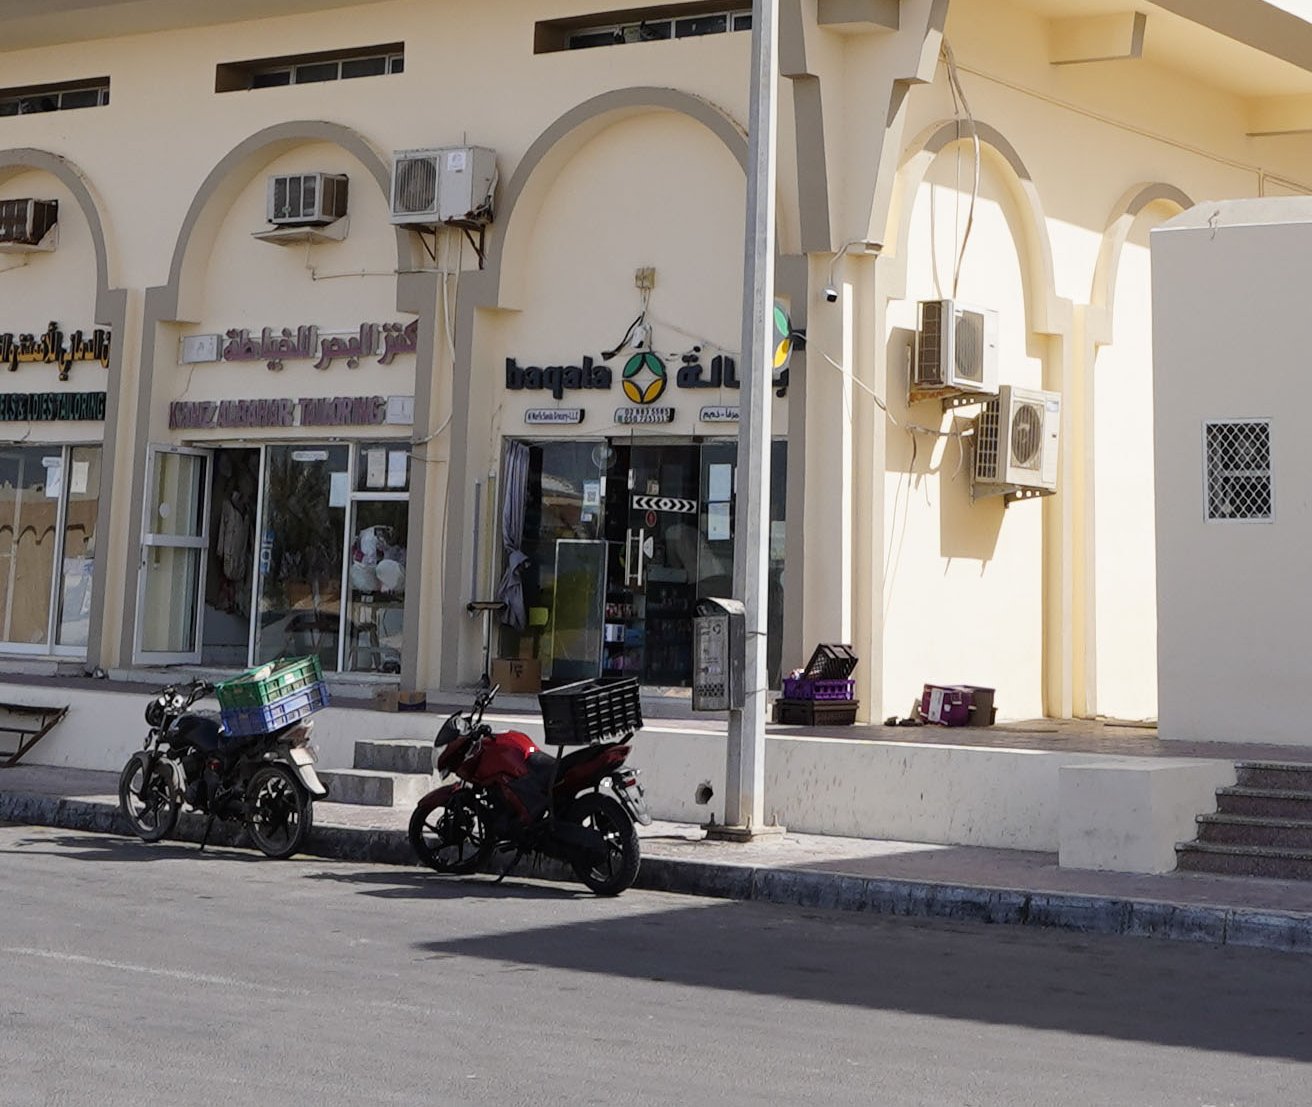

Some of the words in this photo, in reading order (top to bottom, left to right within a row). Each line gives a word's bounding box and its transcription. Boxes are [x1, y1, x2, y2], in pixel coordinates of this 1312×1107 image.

[314, 322, 381, 371] البحر
[505, 356, 612, 400] baqala
[55, 392, 106, 421] TAILORING
